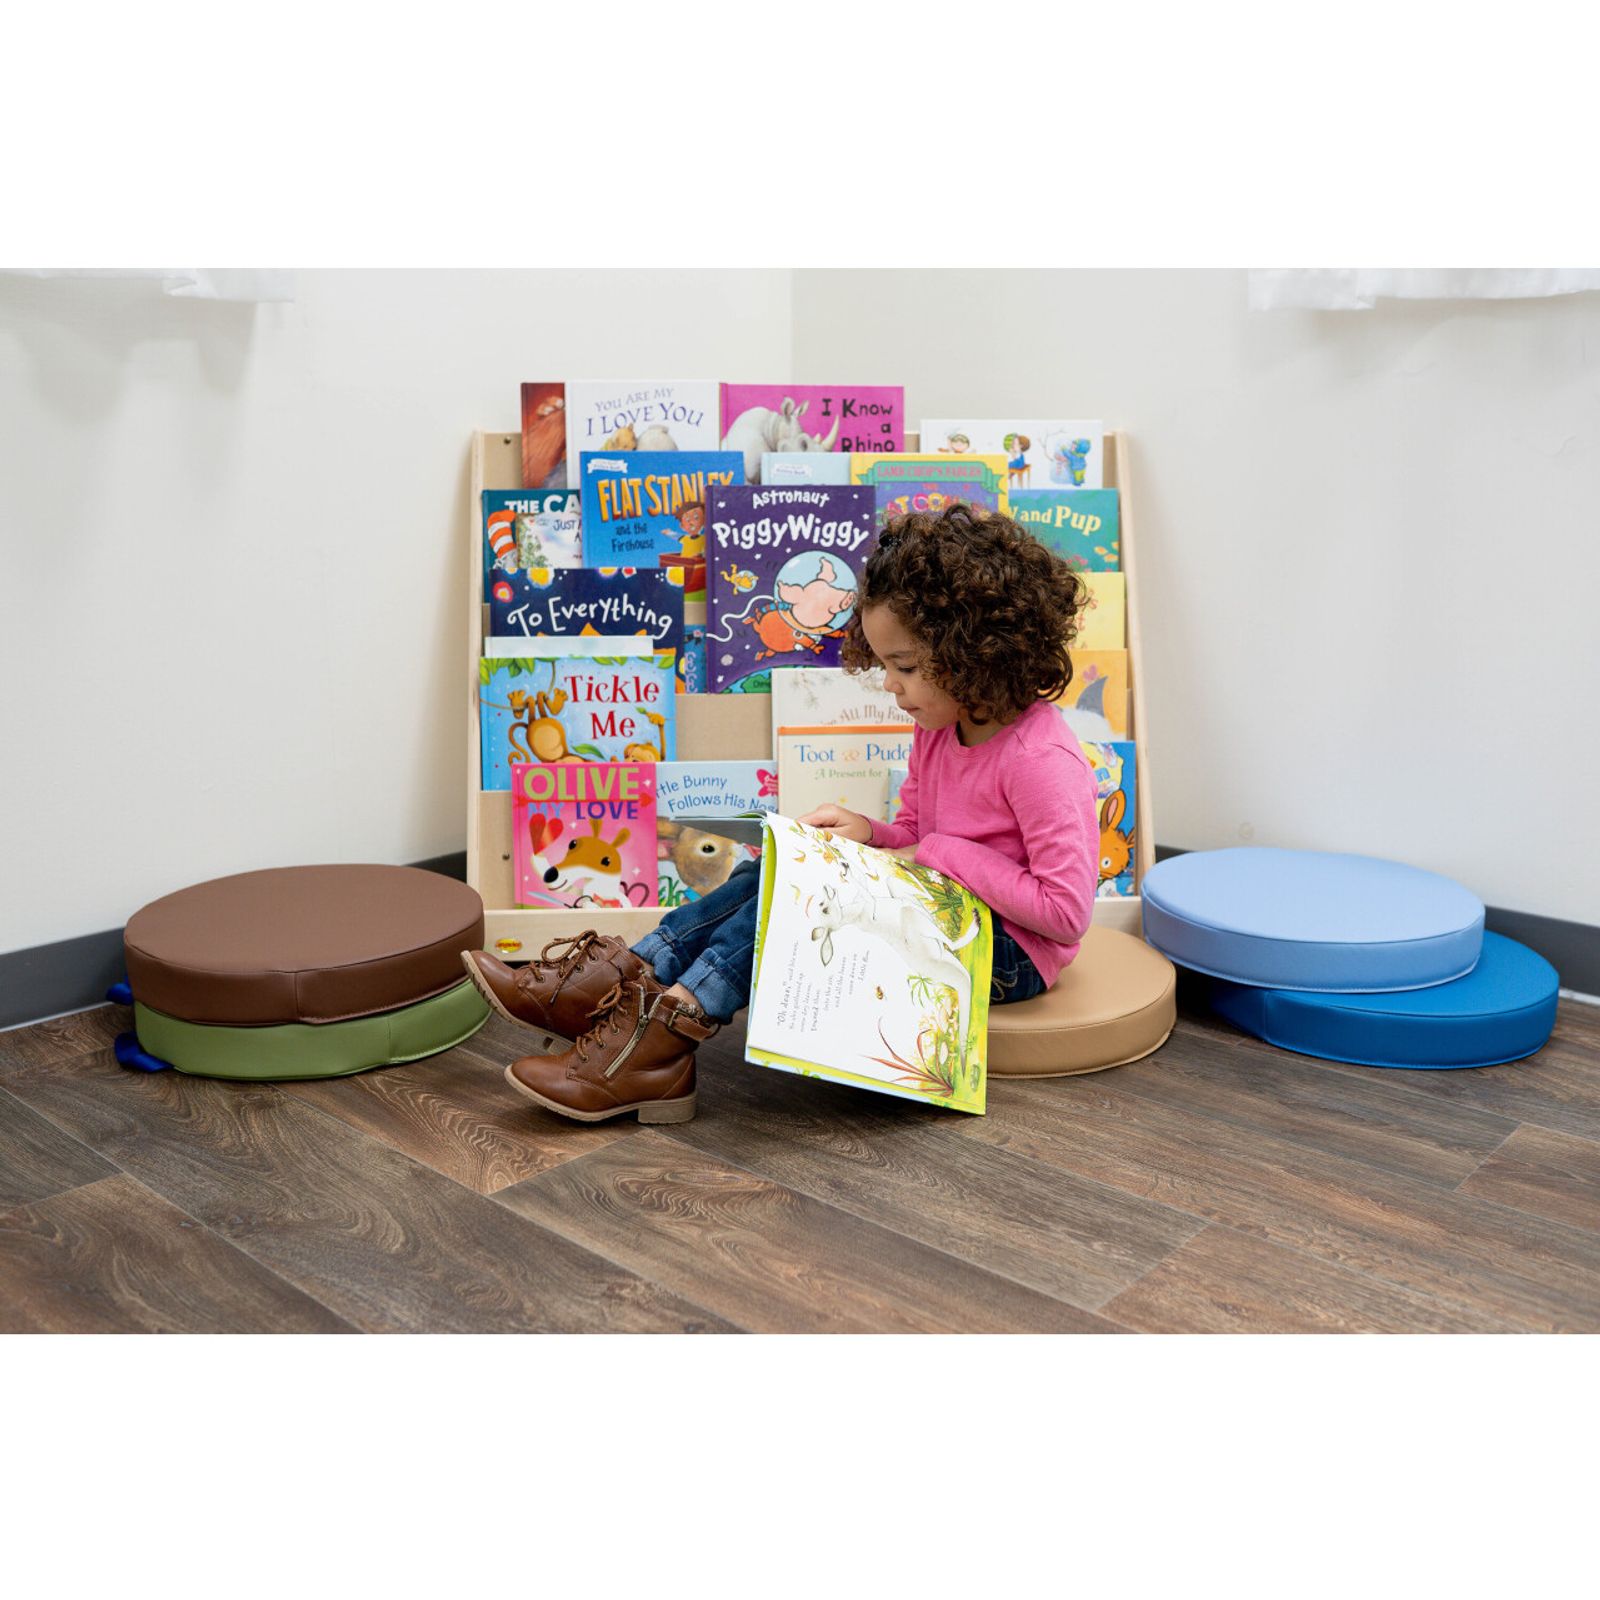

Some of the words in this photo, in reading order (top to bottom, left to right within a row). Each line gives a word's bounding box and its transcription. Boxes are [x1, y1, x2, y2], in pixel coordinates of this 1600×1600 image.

[595, 399, 622, 412] YOU
[626, 391, 649, 404] ARE
[653, 387, 674, 399] MY
[822, 398, 832, 416] I
[842, 398, 893, 418] Know
[586, 418, 592, 436] I
[601, 406, 654, 434] LOVE
[659, 402, 704, 427] YOU
[881, 423, 892, 434] a
[841, 433, 895, 453] Rhino
[504, 499, 540, 514] THE
[597, 477, 642, 522] FLAT
[752, 490, 830, 509] Astronaut
[1020, 508, 1053, 524] and
[1054, 505, 1102, 537] Pup
[712, 513, 870, 551] PiggyWiggy
[507, 603, 543, 637] To
[548, 593, 673, 640] Everything
[564, 674, 660, 703] Tickle
[840, 708, 860, 721] All
[864, 704, 885, 724] My
[590, 709, 635, 740] Me
[794, 744, 835, 763] Toot
[682, 775, 728, 791] Bunny
[828, 768, 866, 779] Present
[523, 767, 640, 801] OLIVE
[576, 801, 639, 820] LOVE
[667, 794, 722, 813] Follows
[724, 792, 746, 809] His
[748, 798, 779, 813] Nos
